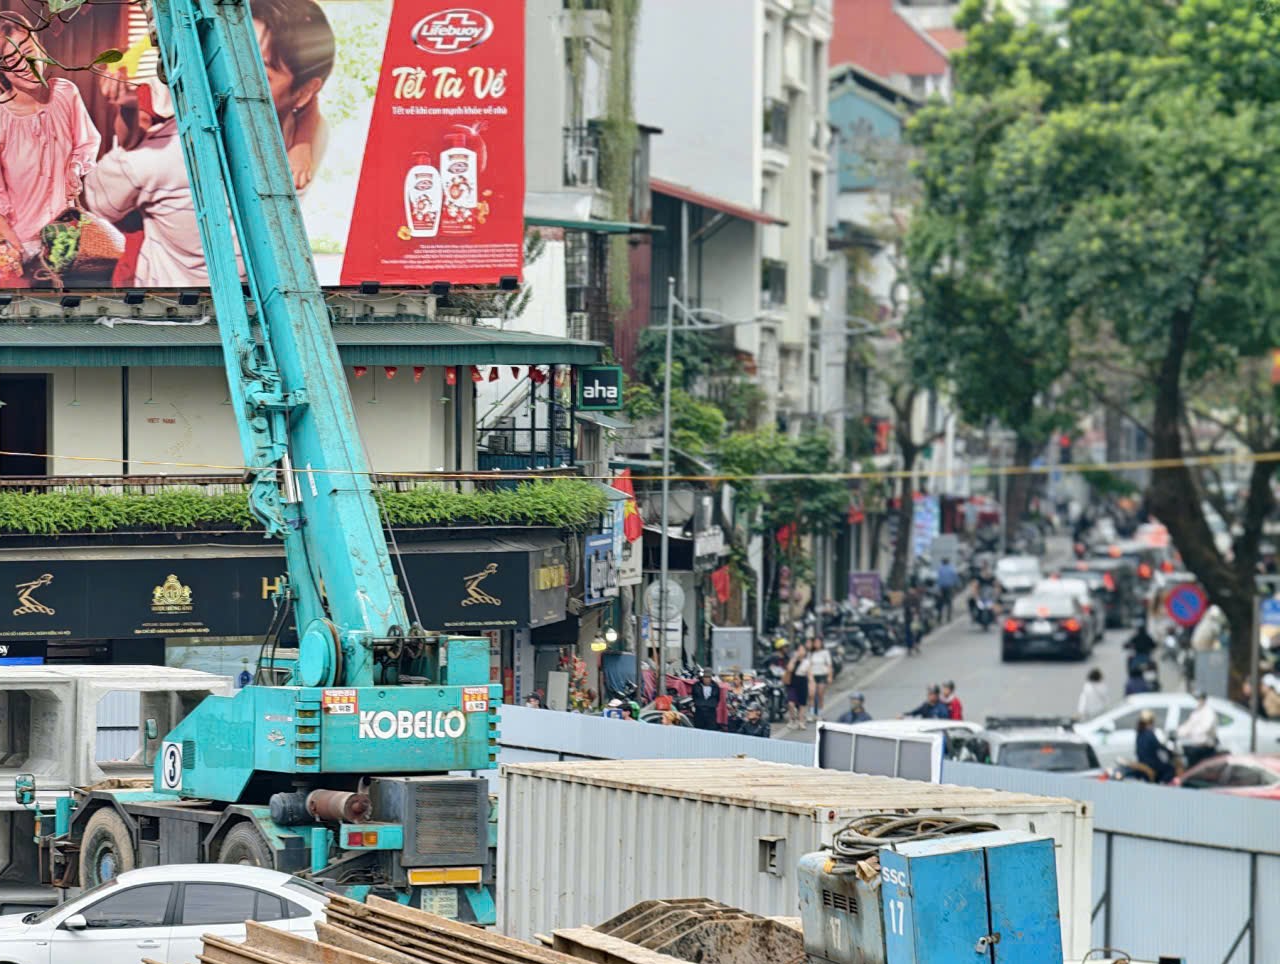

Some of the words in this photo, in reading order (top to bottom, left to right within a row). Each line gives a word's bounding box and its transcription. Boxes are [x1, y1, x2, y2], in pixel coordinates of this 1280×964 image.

[421, 24, 484, 38] Lifebuoy
[391, 66, 427, 100] Tết
[432, 66, 465, 100] Ta
[468, 66, 508, 100] Về
[583, 379, 618, 399] aha
[359, 710, 466, 739] KOBELCO
[169, 750, 176, 782] 3
[882, 865, 906, 888] SSC
[888, 898, 906, 936] 17
